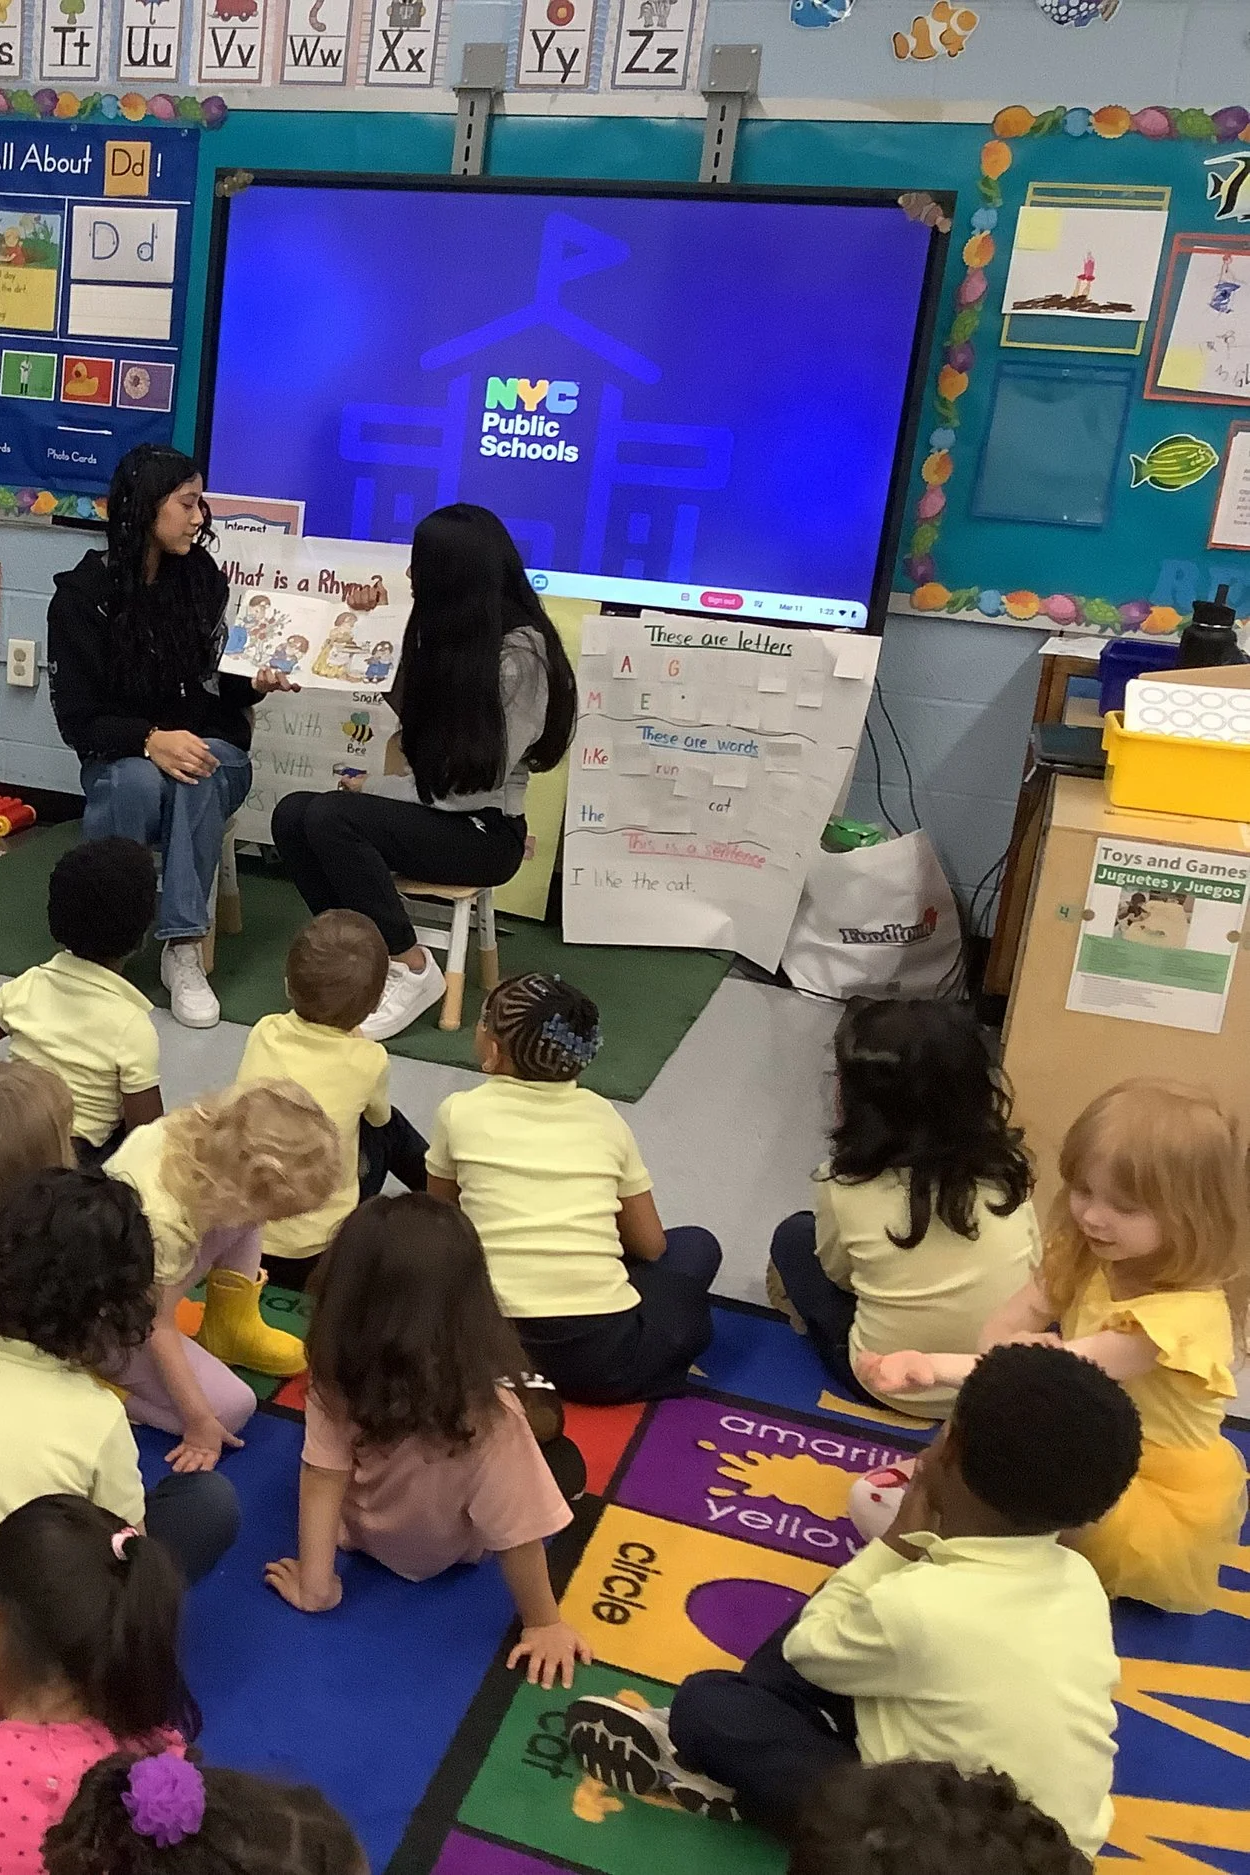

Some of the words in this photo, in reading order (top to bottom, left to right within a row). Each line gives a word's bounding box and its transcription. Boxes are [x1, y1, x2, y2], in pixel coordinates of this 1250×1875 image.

[52, 27, 90, 66] Tt
[127, 28, 173, 67] Uu
[210, 28, 255, 68] Vv
[290, 36, 342, 67] Ww
[377, 30, 425, 72] Xx
[531, 30, 579, 83] Yy
[624, 30, 679, 73] Zz
[20, 143, 92, 175] About
[111, 148, 145, 177] Dd
[485, 376, 580, 414] NYC
[482, 412, 560, 438] Public
[47, 448, 69, 461] Photo
[71, 452, 97, 465] Cards
[480, 435, 579, 463] Schools
[274, 570, 288, 589] is
[297, 577, 309, 592] a
[779, 603, 793, 611] Mar
[795, 604, 803, 612] 11
[819, 607, 835, 616] 1:22
[643, 625, 694, 647] These
[701, 633, 728, 647] are
[738, 630, 793, 656] letters
[621, 655, 633, 674] A
[668, 659, 680, 677] G
[640, 693, 652, 711] E
[283, 712, 322, 737] With
[347, 744, 367, 756] Bee
[636, 725, 679, 746] These
[684, 735, 708, 749] are
[717, 738, 759, 755] words
[274, 754, 314, 778] With
[656, 764, 679, 775] run
[581, 805, 605, 823] the
[709, 797, 732, 813] cat
[622, 832, 655, 850] This
[1102, 847, 1143, 865] Toys
[1147, 854, 1181, 871] and
[1186, 859, 1248, 880] Games
[570, 867, 585, 887] I
[594, 868, 623, 888] like
[632, 871, 660, 891] the
[1098, 867, 1168, 889] Juguetes
[1172, 880, 1182, 893] y
[1184, 881, 1241, 900] Juegos
[839, 923, 935, 945] Foodto
[720, 1415, 902, 1467] amarill
[592, 1541, 663, 1625] circle
